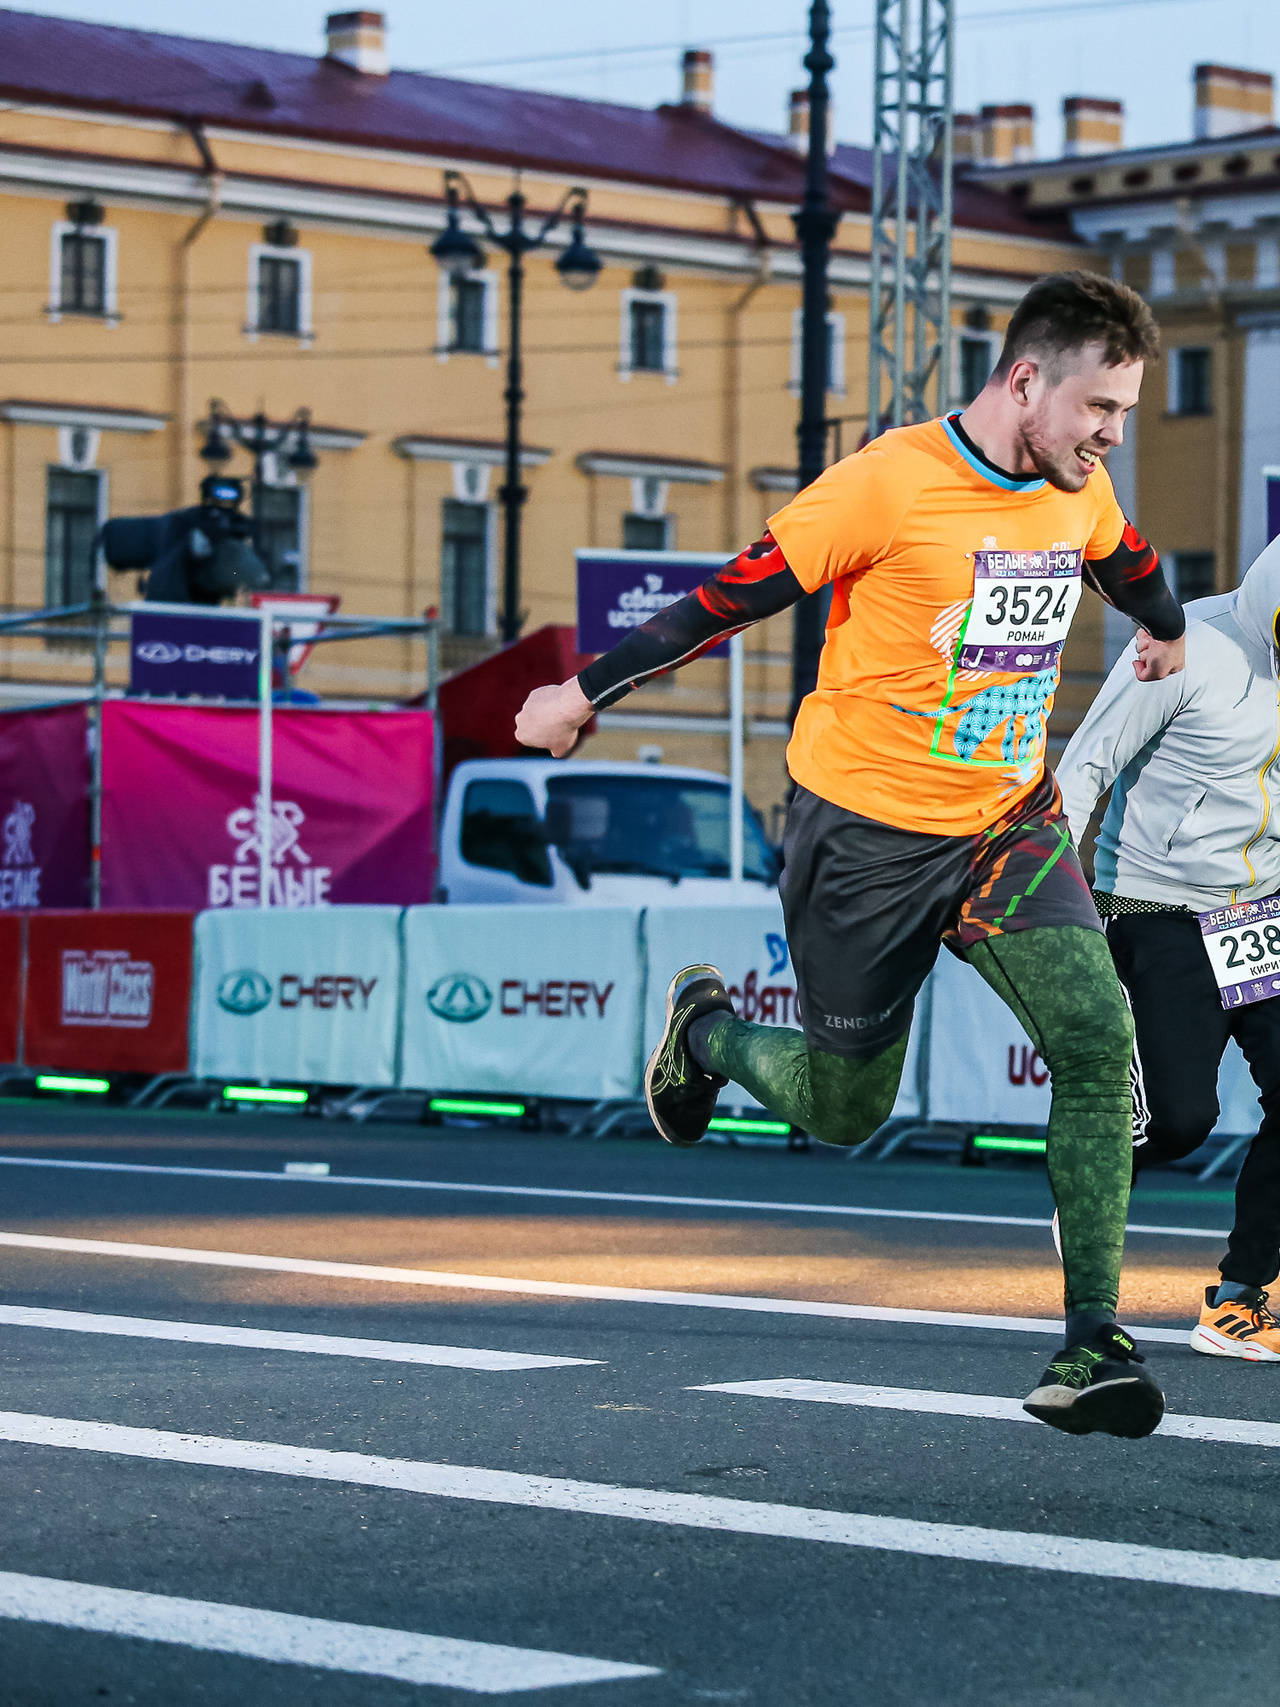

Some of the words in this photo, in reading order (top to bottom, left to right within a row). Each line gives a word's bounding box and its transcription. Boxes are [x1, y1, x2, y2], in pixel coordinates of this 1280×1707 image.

[987, 553, 1027, 569] БЕЛЫЕ
[985, 584, 1070, 625] 3524
[1006, 630, 1045, 642] РОМАН
[208, 865, 331, 908] БЕЛЫЕ
[1209, 906, 1246, 926] БЕЛЫЕ
[280, 974, 378, 1009] CHERY
[501, 980, 614, 1018] CHERY
[824, 1008, 891, 1029] ZENDEN
